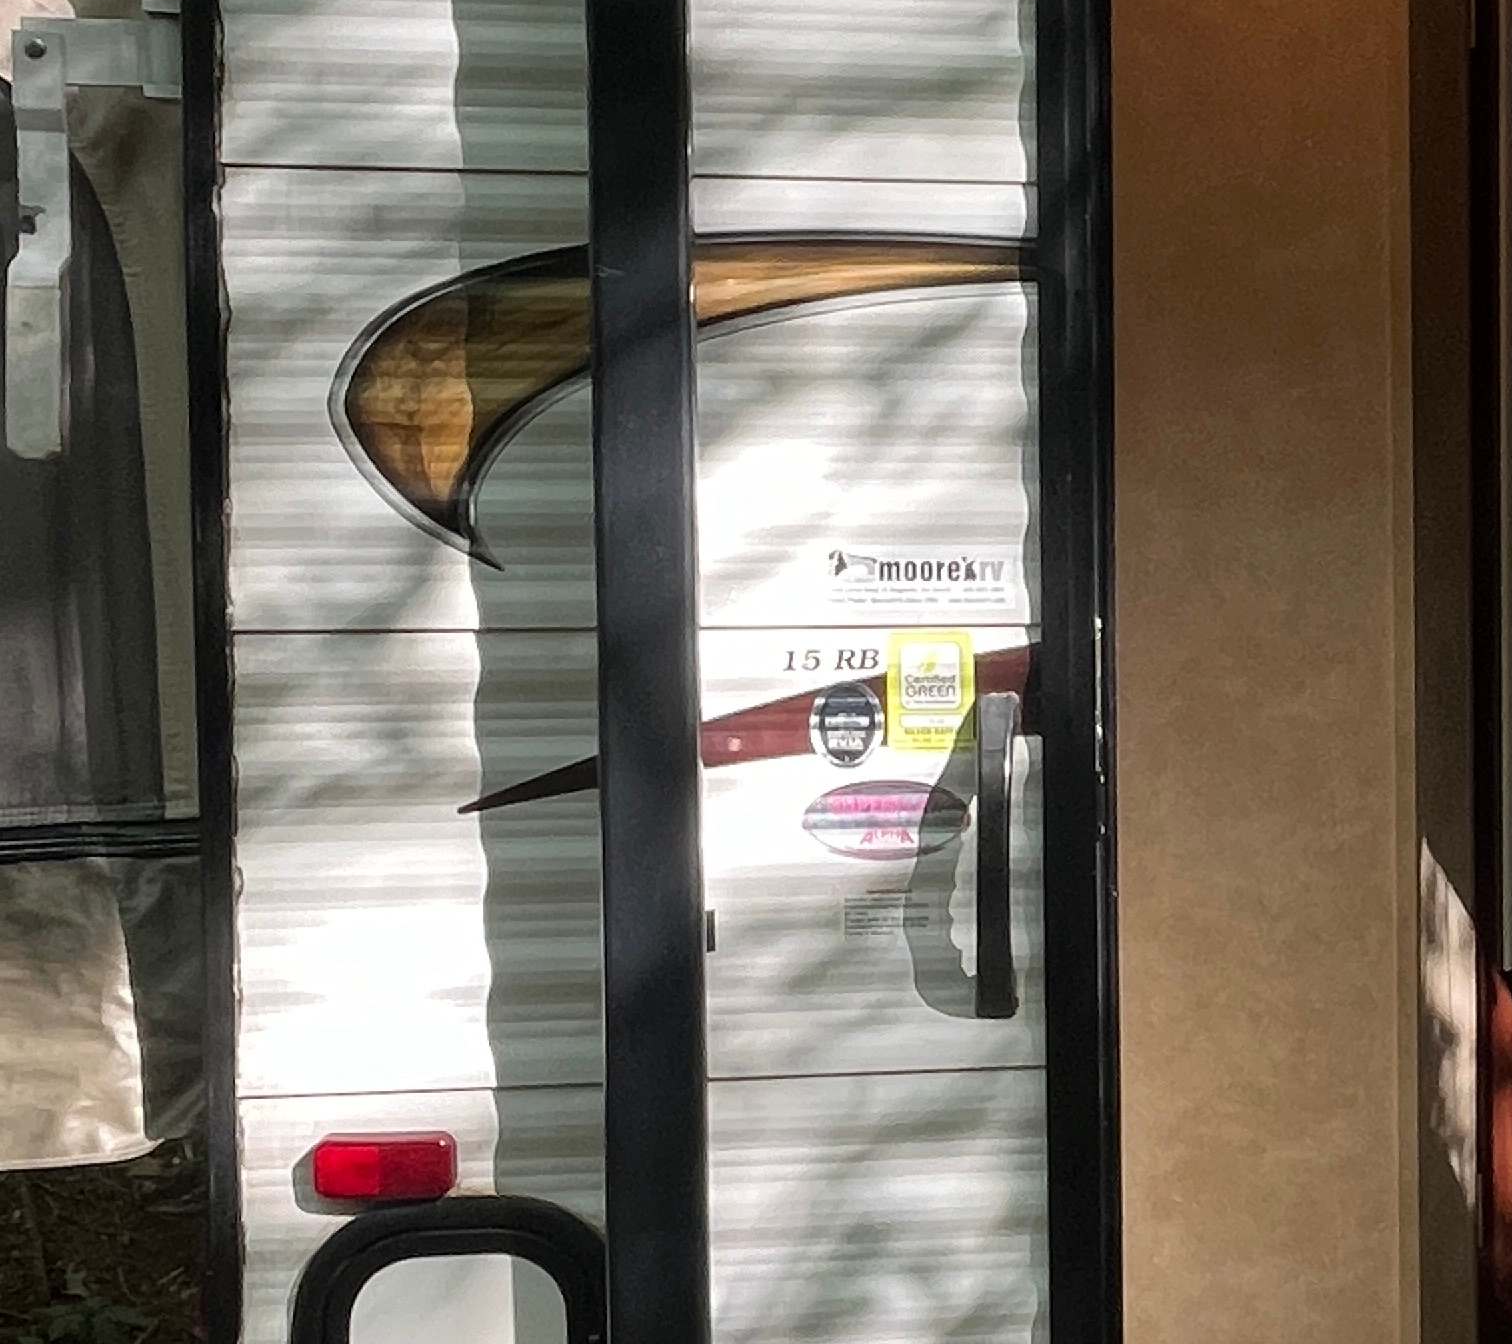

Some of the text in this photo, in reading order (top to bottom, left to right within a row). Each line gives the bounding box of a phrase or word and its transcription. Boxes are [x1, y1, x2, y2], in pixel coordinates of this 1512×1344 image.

[782, 648, 880, 673] 15 RB
[904, 684, 957, 698] GREEN
